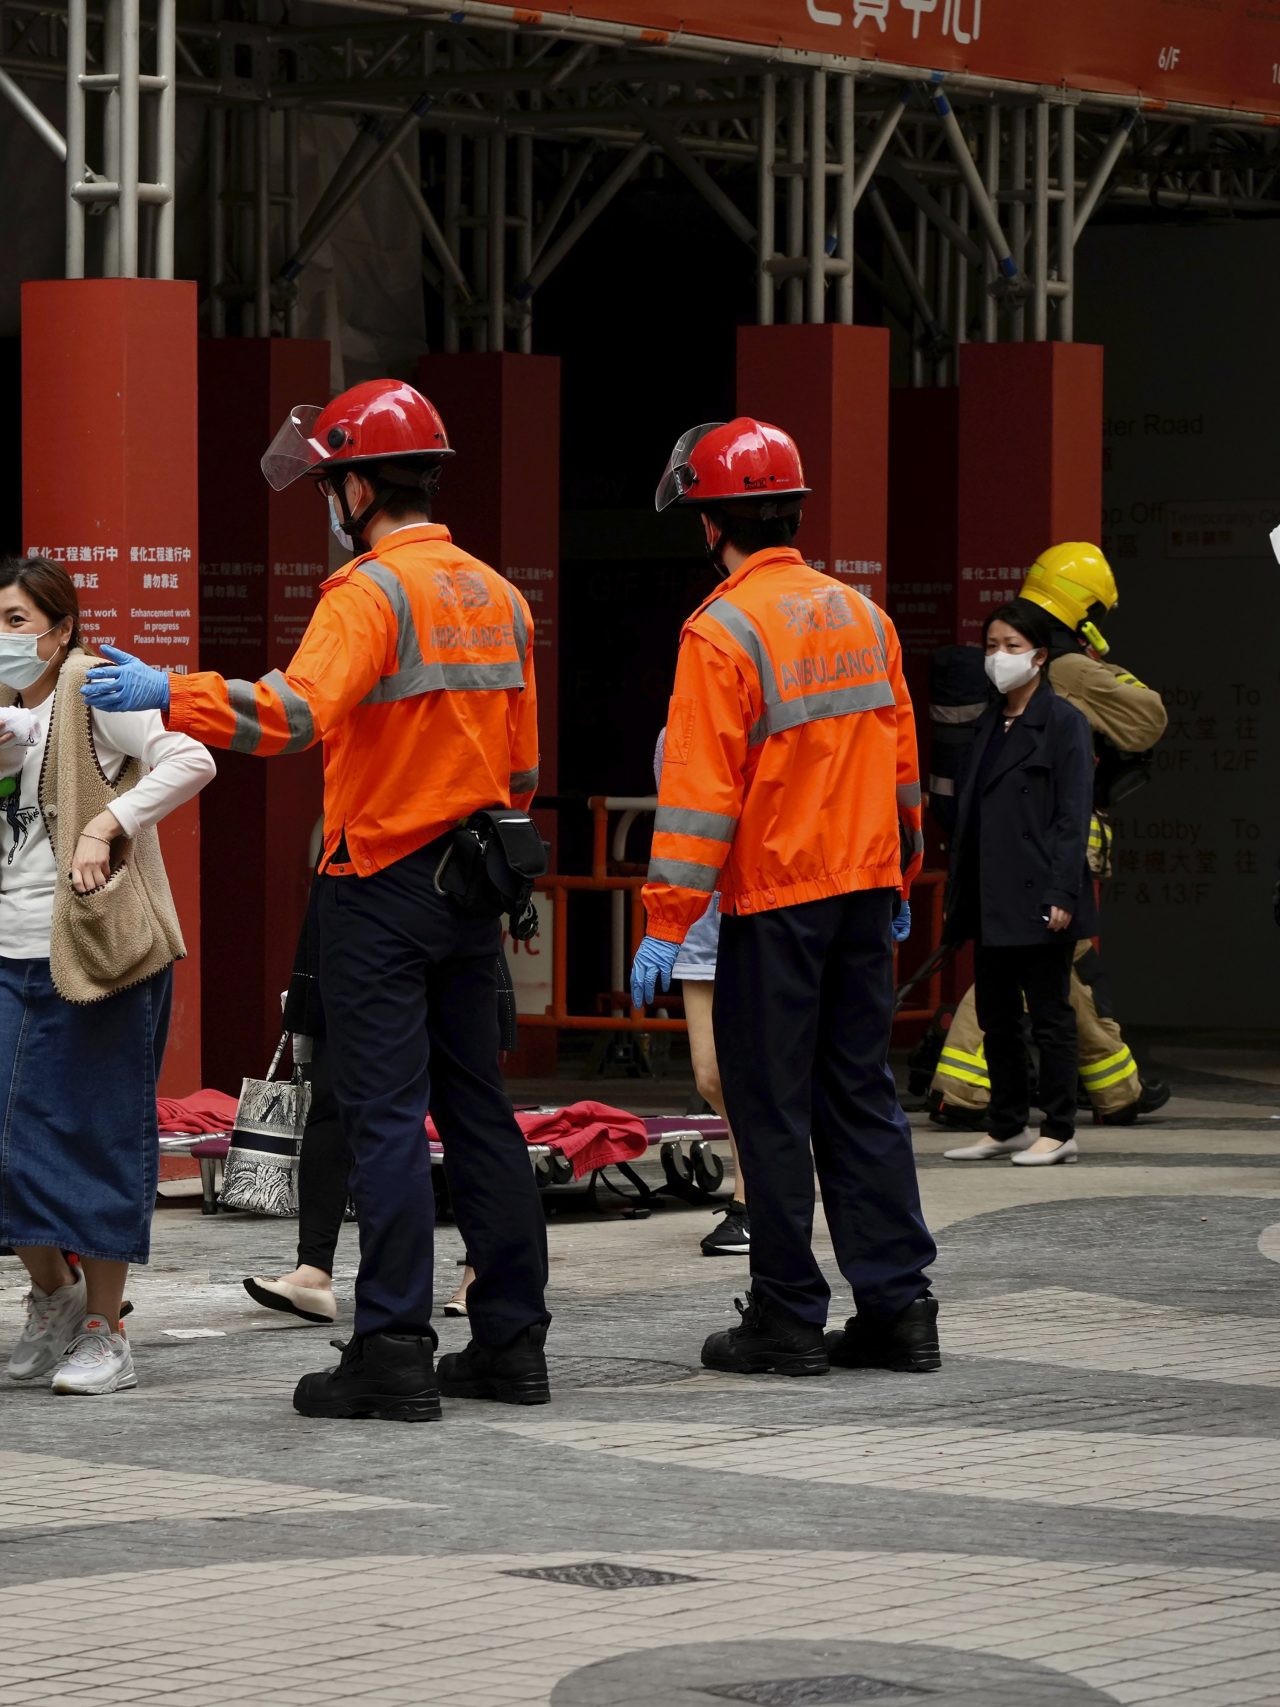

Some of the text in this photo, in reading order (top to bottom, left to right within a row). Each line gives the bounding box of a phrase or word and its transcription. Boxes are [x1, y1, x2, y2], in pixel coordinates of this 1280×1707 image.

[1158, 46, 1181, 71] 6/F
[1144, 413, 1203, 435] Road
[130, 547, 192, 562] 優化工程進行中
[143, 573, 179, 589] 請勿靠近
[94, 608, 117, 617] work
[130, 608, 174, 618] Enhancement
[175, 608, 191, 618] work
[144, 621, 180, 633] in progress
[91, 635, 116, 646] away
[133, 634, 155, 644] Please
[156, 634, 172, 646] keep
[173, 636, 190, 646] away
[780, 645, 887, 691] AMBULANCE
[1231, 683, 1261, 706] To
[1208, 748, 1259, 771] 12/F
[1132, 817, 1202, 846] Lobby
[1230, 817, 1261, 841] To
[1161, 881, 1210, 905] 13/F
